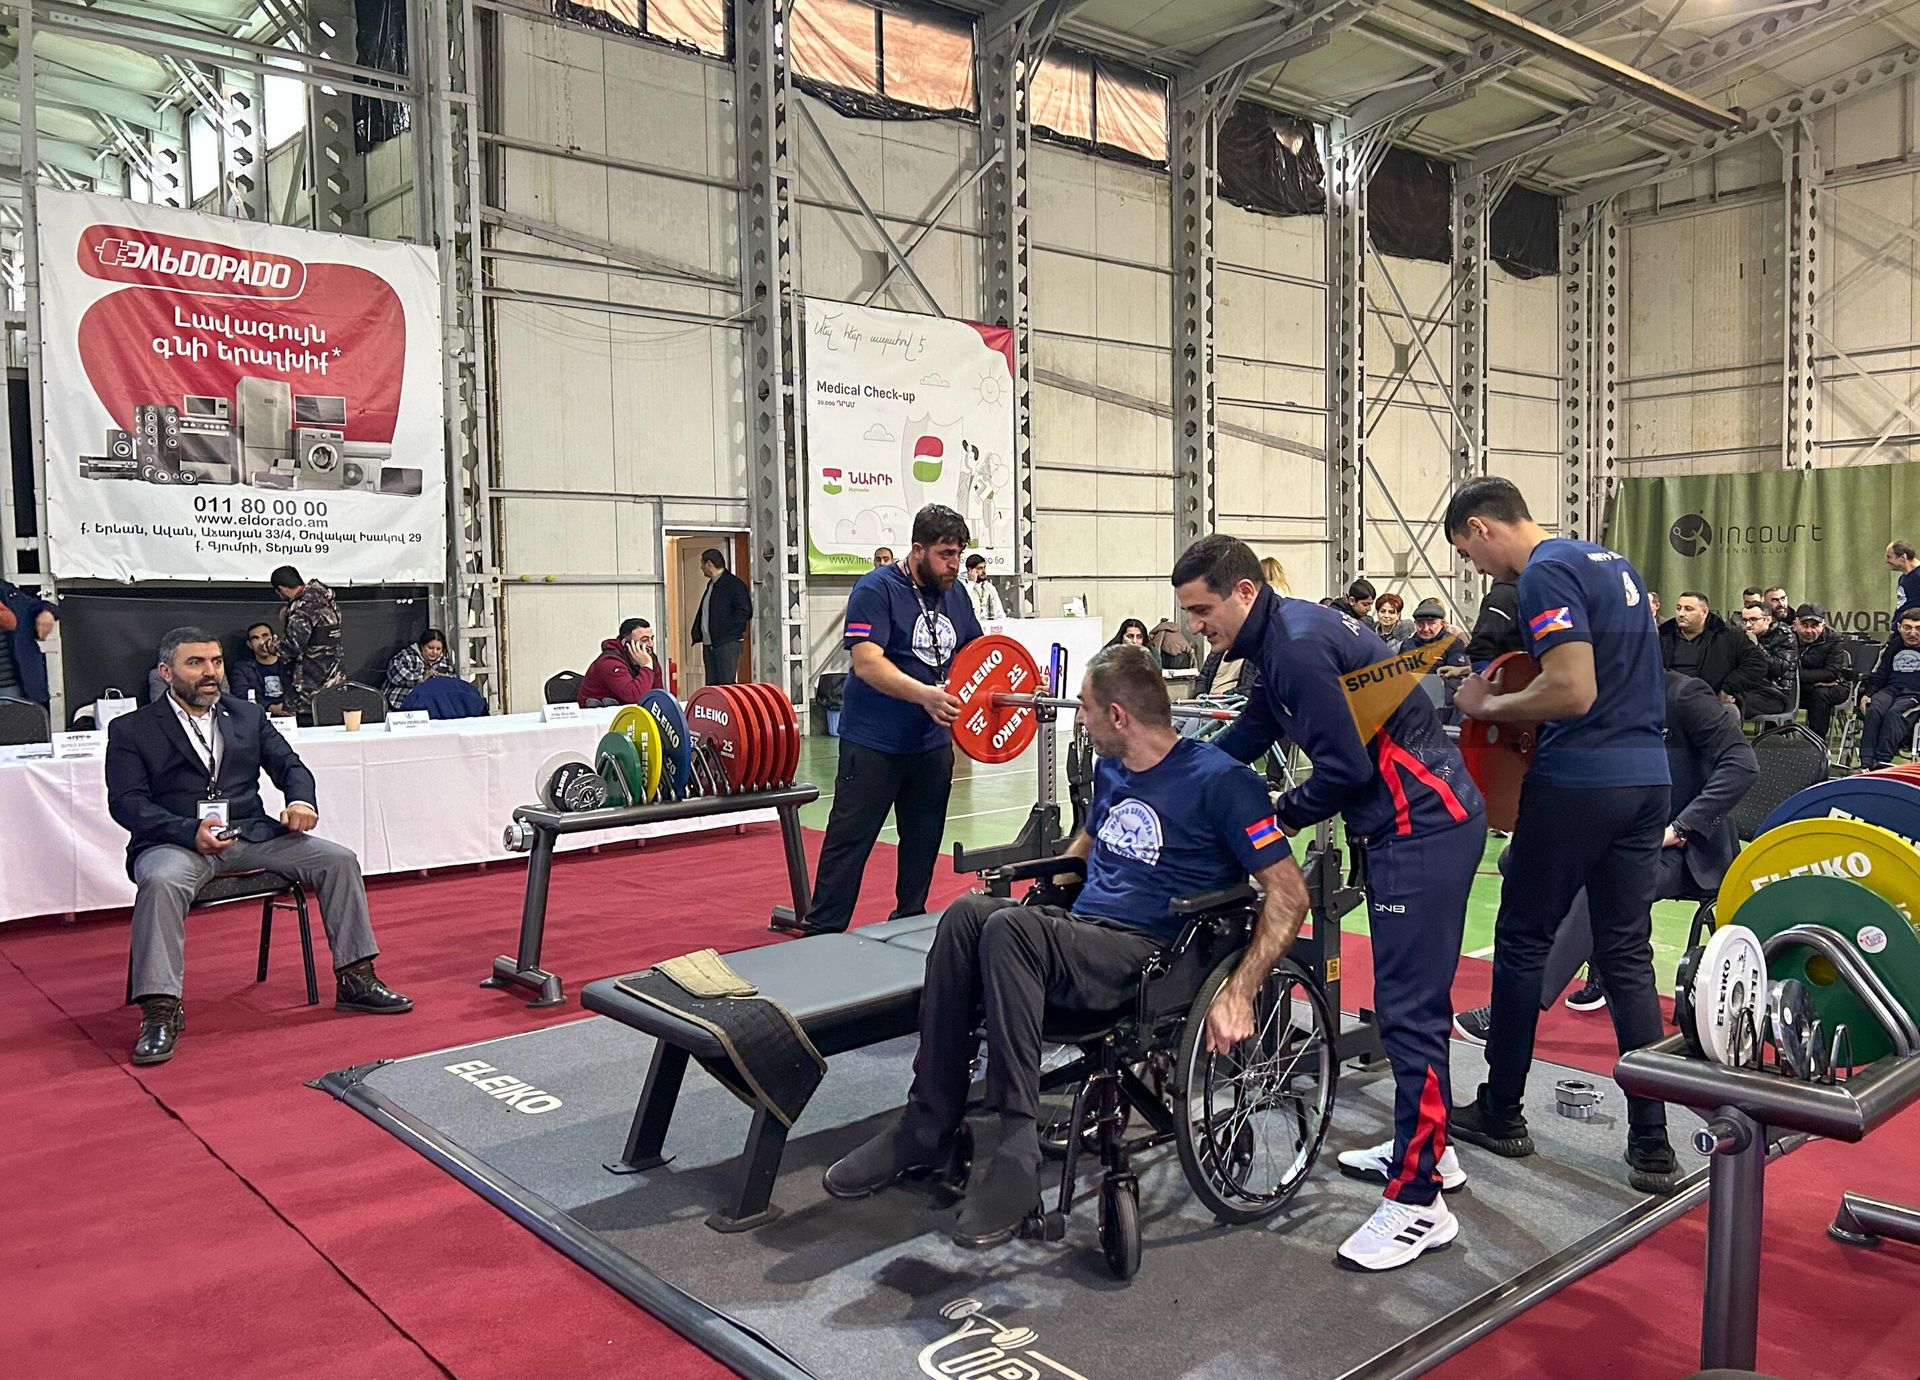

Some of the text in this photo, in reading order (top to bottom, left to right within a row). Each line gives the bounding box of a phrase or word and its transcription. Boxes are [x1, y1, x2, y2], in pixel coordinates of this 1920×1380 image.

[174, 305, 326, 346] Լավագույն
[152, 335, 208, 363] գնի
[817, 380, 916, 404] Medical Check-up
[848, 471, 893, 486] ՆԱԻՐԻ
[193, 496, 328, 517] 011 80 00 00
[194, 514, 329, 528] www.eldorado.am
[152, 525, 197, 538] Ավան,
[265, 529, 296, 541] 33/4,
[408, 533, 422, 542] 29
[265, 543, 312, 555] Տերյան
[314, 544, 329, 553] 99
[1826, 611, 1890, 632] WOR
[958, 649, 1003, 704] ELEIKO
[1007, 663, 1023, 684] 25
[650, 701, 680, 748] ELEIKO
[694, 704, 729, 726] ELEIKO
[971, 715, 988, 736] 25
[992, 707, 1032, 749] LEIKO
[722, 739, 733, 752] 25
[641, 731, 649, 787] ELEIKO
[665, 757, 676, 775] 20
[555, 770, 569, 798] ELEIKO
[1716, 959, 1731, 1027] ELEIKO
[1750, 968, 1759, 1014] ELEI
[443, 1059, 563, 1114] ELEIKO
